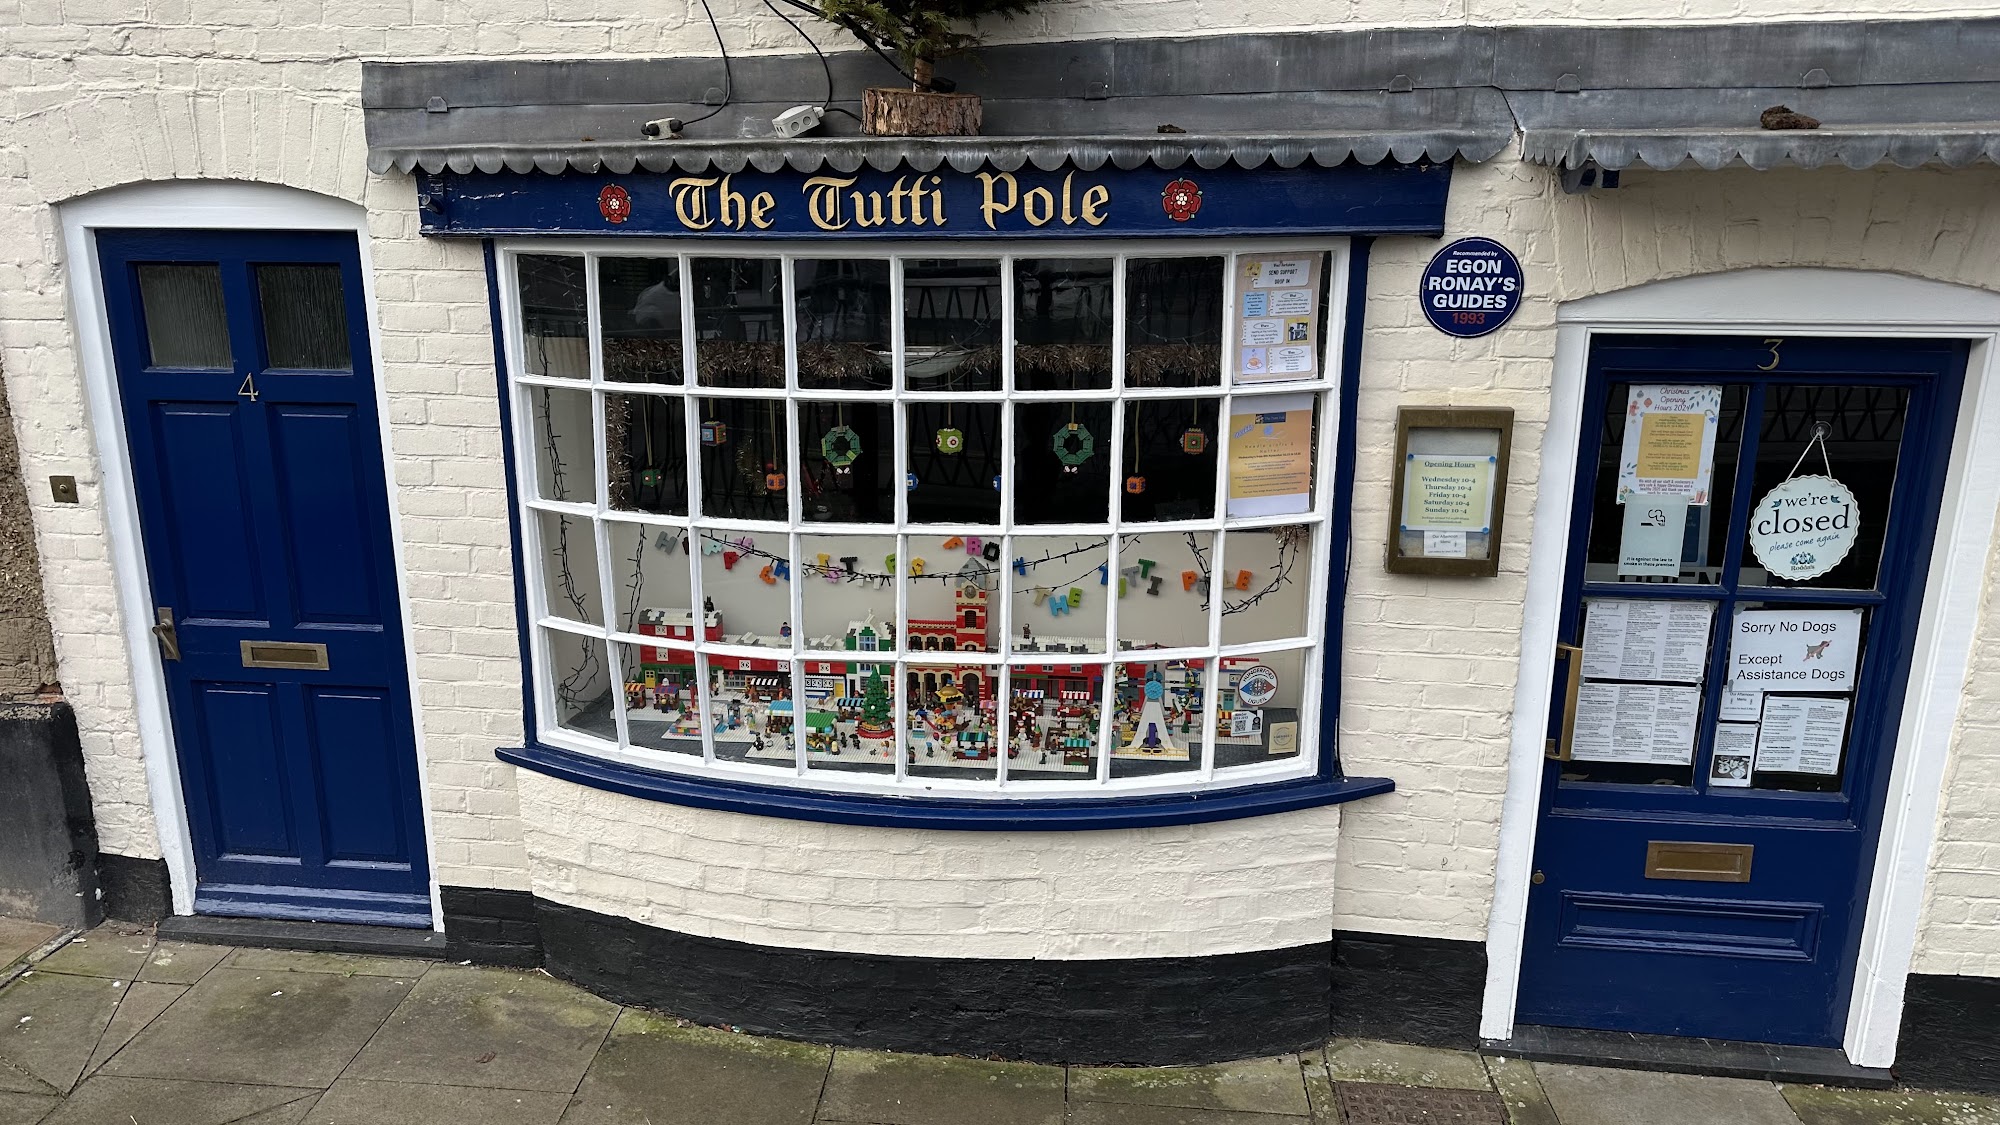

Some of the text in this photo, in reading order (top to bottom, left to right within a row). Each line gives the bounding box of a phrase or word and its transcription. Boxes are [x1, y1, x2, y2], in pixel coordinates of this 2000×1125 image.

[669, 170, 1108, 230] The Tutti Pole
[1446, 259, 1502, 274] EGON
[1428, 276, 1516, 291] RONAY'S
[1433, 294, 1507, 309] GUIDES
[1452, 312, 1485, 324] 1993
[1757, 339, 1784, 370] 3
[238, 372, 259, 401] 4
[1660, 387, 1690, 395] Christmas
[1660, 396, 1686, 404] Opening
[1422, 476, 1460, 484] Wednesday
[1424, 499, 1454, 507] Saturday
[1785, 492, 1828, 508] we're
[1757, 504, 1850, 536] closed
[1769, 532, 1840, 555] please come again
[1034, 585, 1083, 616] THE
[1741, 621, 1837, 634] Sorry No Dogs
[1738, 654, 1782, 666] Except
[1243, 667, 1274, 682] HUNGERFORD
[1736, 669, 1845, 682] Assistance Dogs
